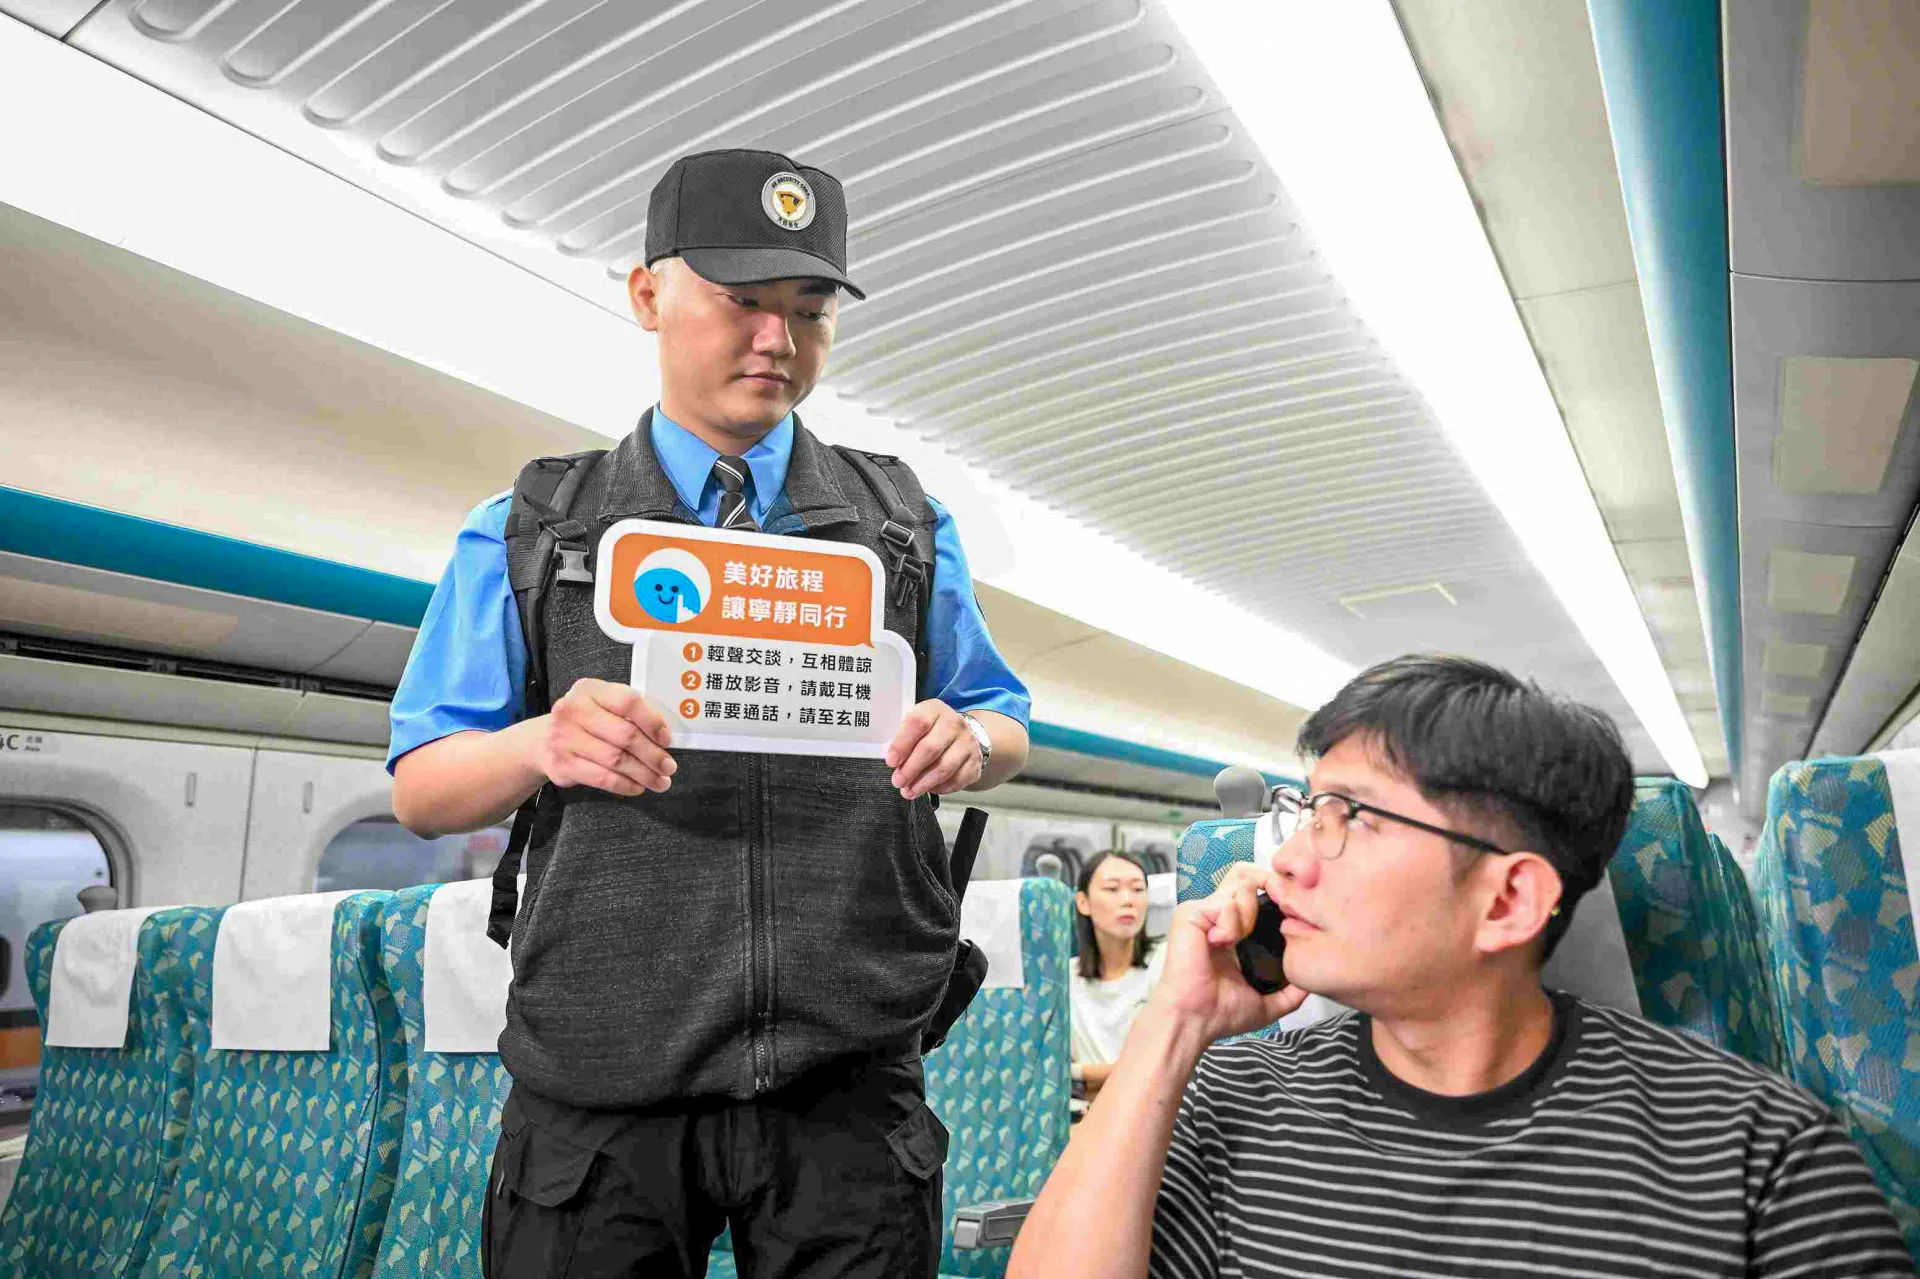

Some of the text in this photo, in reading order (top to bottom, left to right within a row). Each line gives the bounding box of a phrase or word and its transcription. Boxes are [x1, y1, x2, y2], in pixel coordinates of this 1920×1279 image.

[723, 560, 824, 593] 美好旅程
[721, 595, 848, 629] 讓寧靜同行
[707, 645, 872, 673] 輕聲交談，互相體諒
[706, 672, 871, 700] 播放影音，請戴耳機
[704, 701, 870, 728] 需要通話，請至玄關
